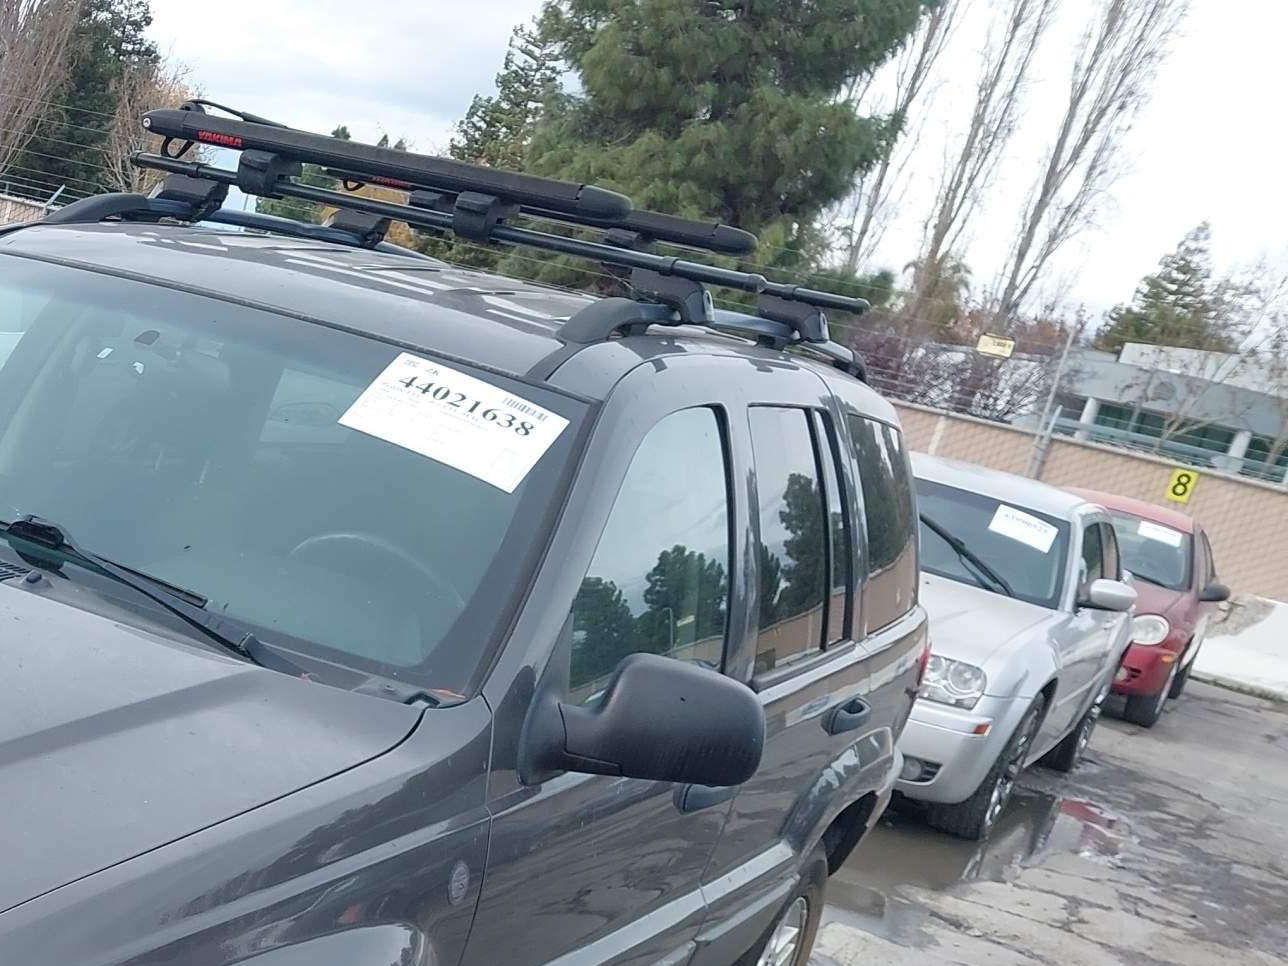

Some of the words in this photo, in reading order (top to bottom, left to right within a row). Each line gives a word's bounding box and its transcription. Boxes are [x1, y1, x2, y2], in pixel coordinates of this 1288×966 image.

[199, 130, 242, 147] YAKIMA
[398, 375, 535, 436] 44021638
[1172, 473, 1192, 496] 8
